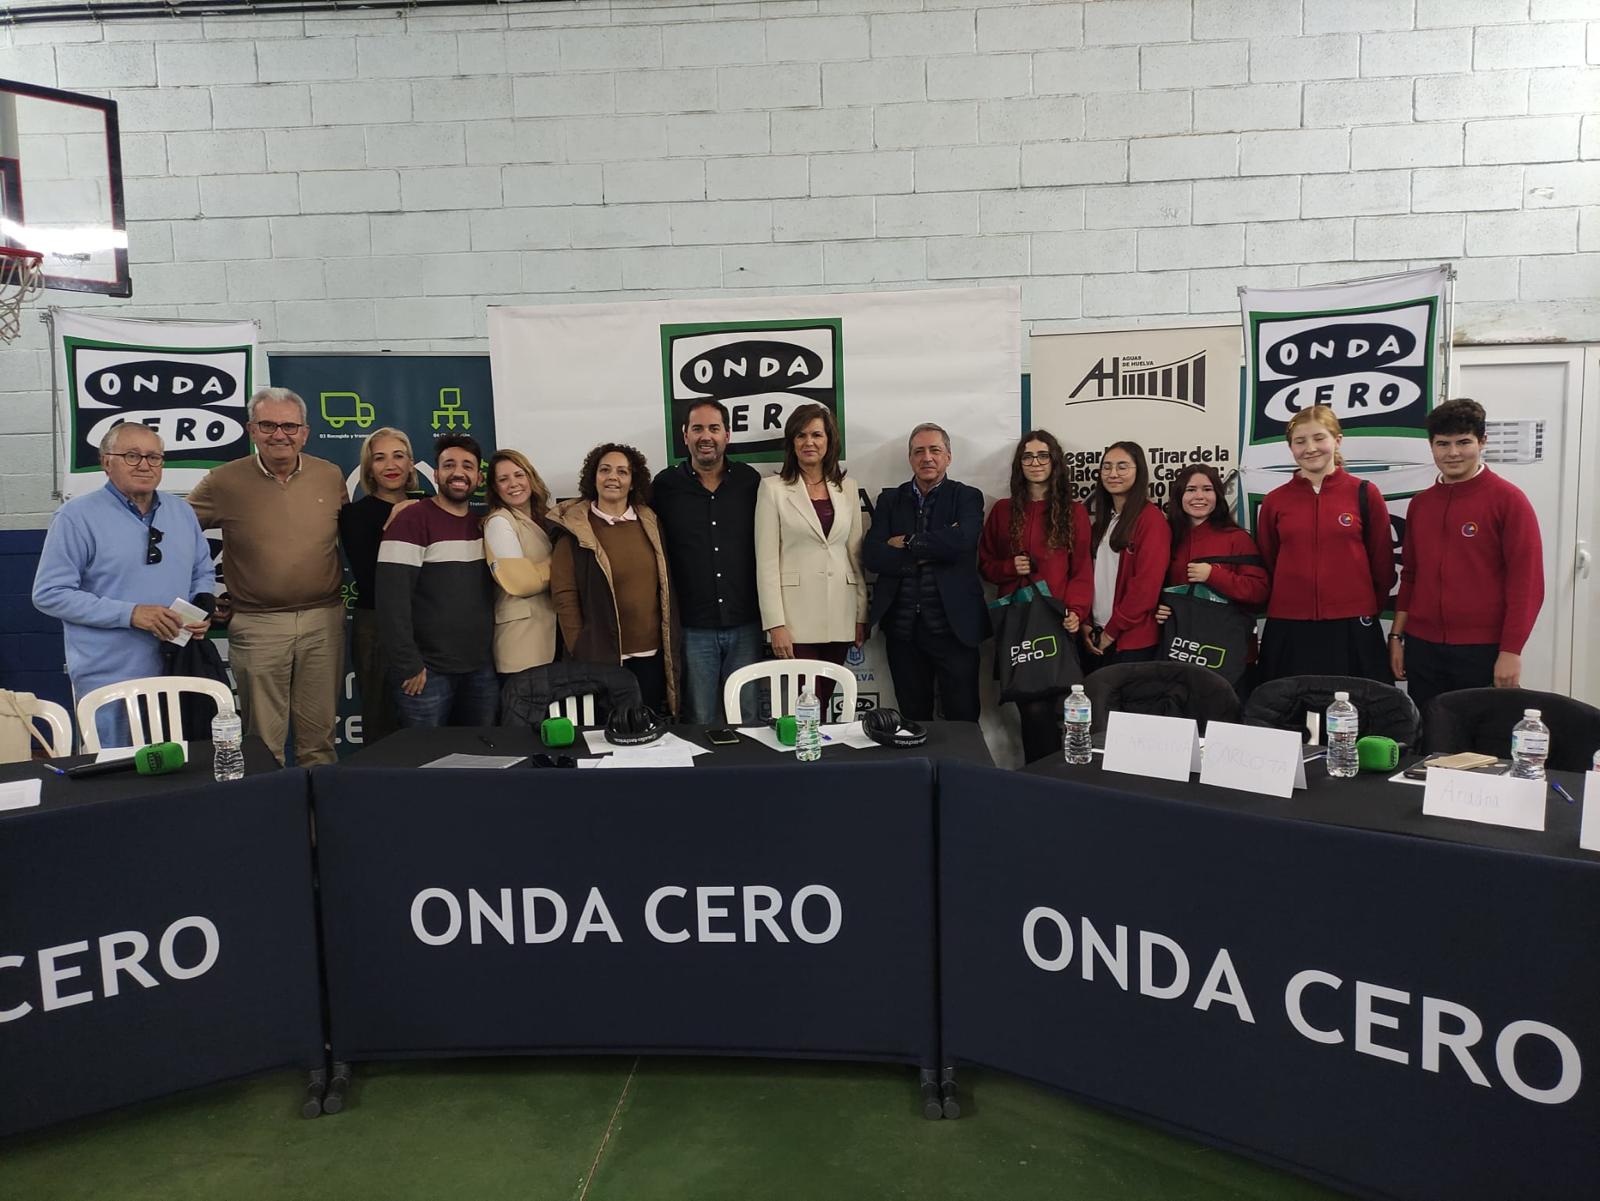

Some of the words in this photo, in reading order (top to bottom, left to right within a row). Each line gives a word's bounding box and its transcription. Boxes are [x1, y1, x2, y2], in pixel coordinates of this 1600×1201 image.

[1279, 335, 1401, 366] ONDA
[100, 372, 223, 396] ONDA
[694, 355, 810, 384] ONDA
[1284, 382, 1400, 414] CERO
[732, 402, 783, 433] ER
[1148, 448, 1186, 464] Tirar
[1189, 445, 1213, 462] de
[1215, 445, 1229, 461] la
[1168, 648, 1208, 667] zero
[1171, 636, 1201, 652] pre
[410, 886, 624, 946] ONDA
[644, 884, 843, 945] CERO
[1022, 906, 1256, 1025] ONDA
[1283, 969, 1583, 1105] CERO
